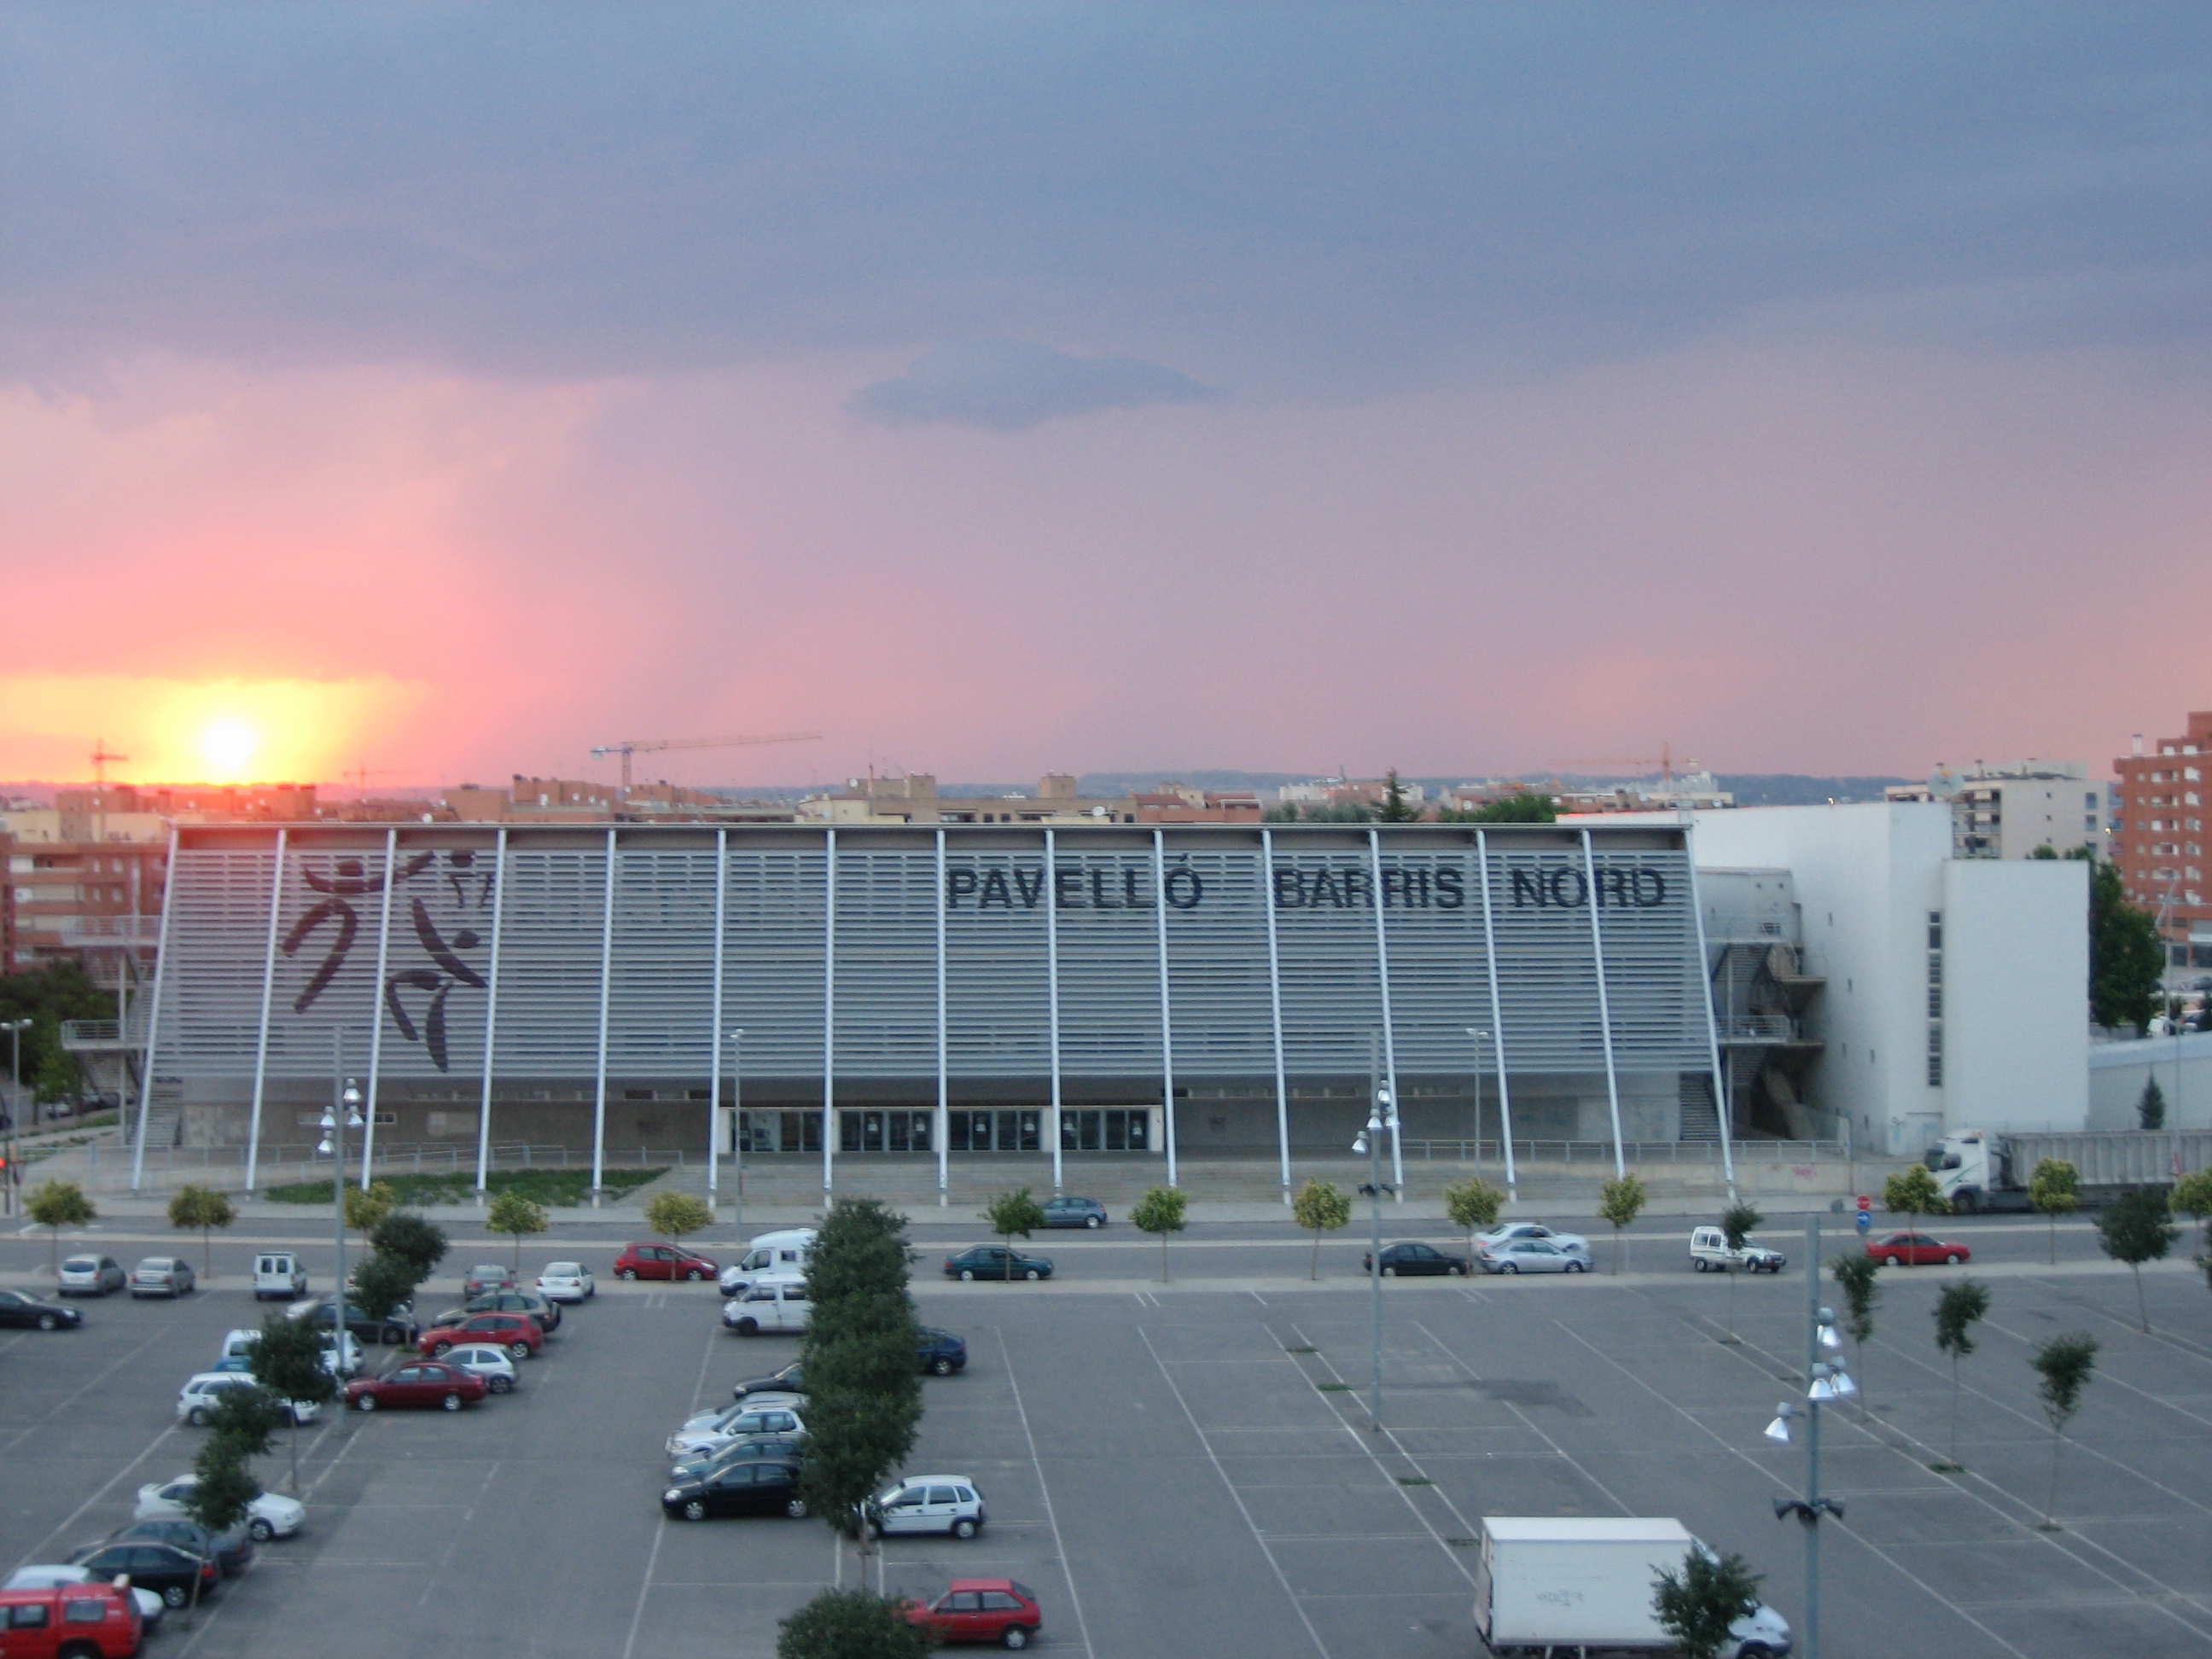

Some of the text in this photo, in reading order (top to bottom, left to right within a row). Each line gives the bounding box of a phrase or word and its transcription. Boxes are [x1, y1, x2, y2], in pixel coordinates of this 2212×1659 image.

[948, 853, 1664, 909] PAVELLÓ BARRIS NORD
